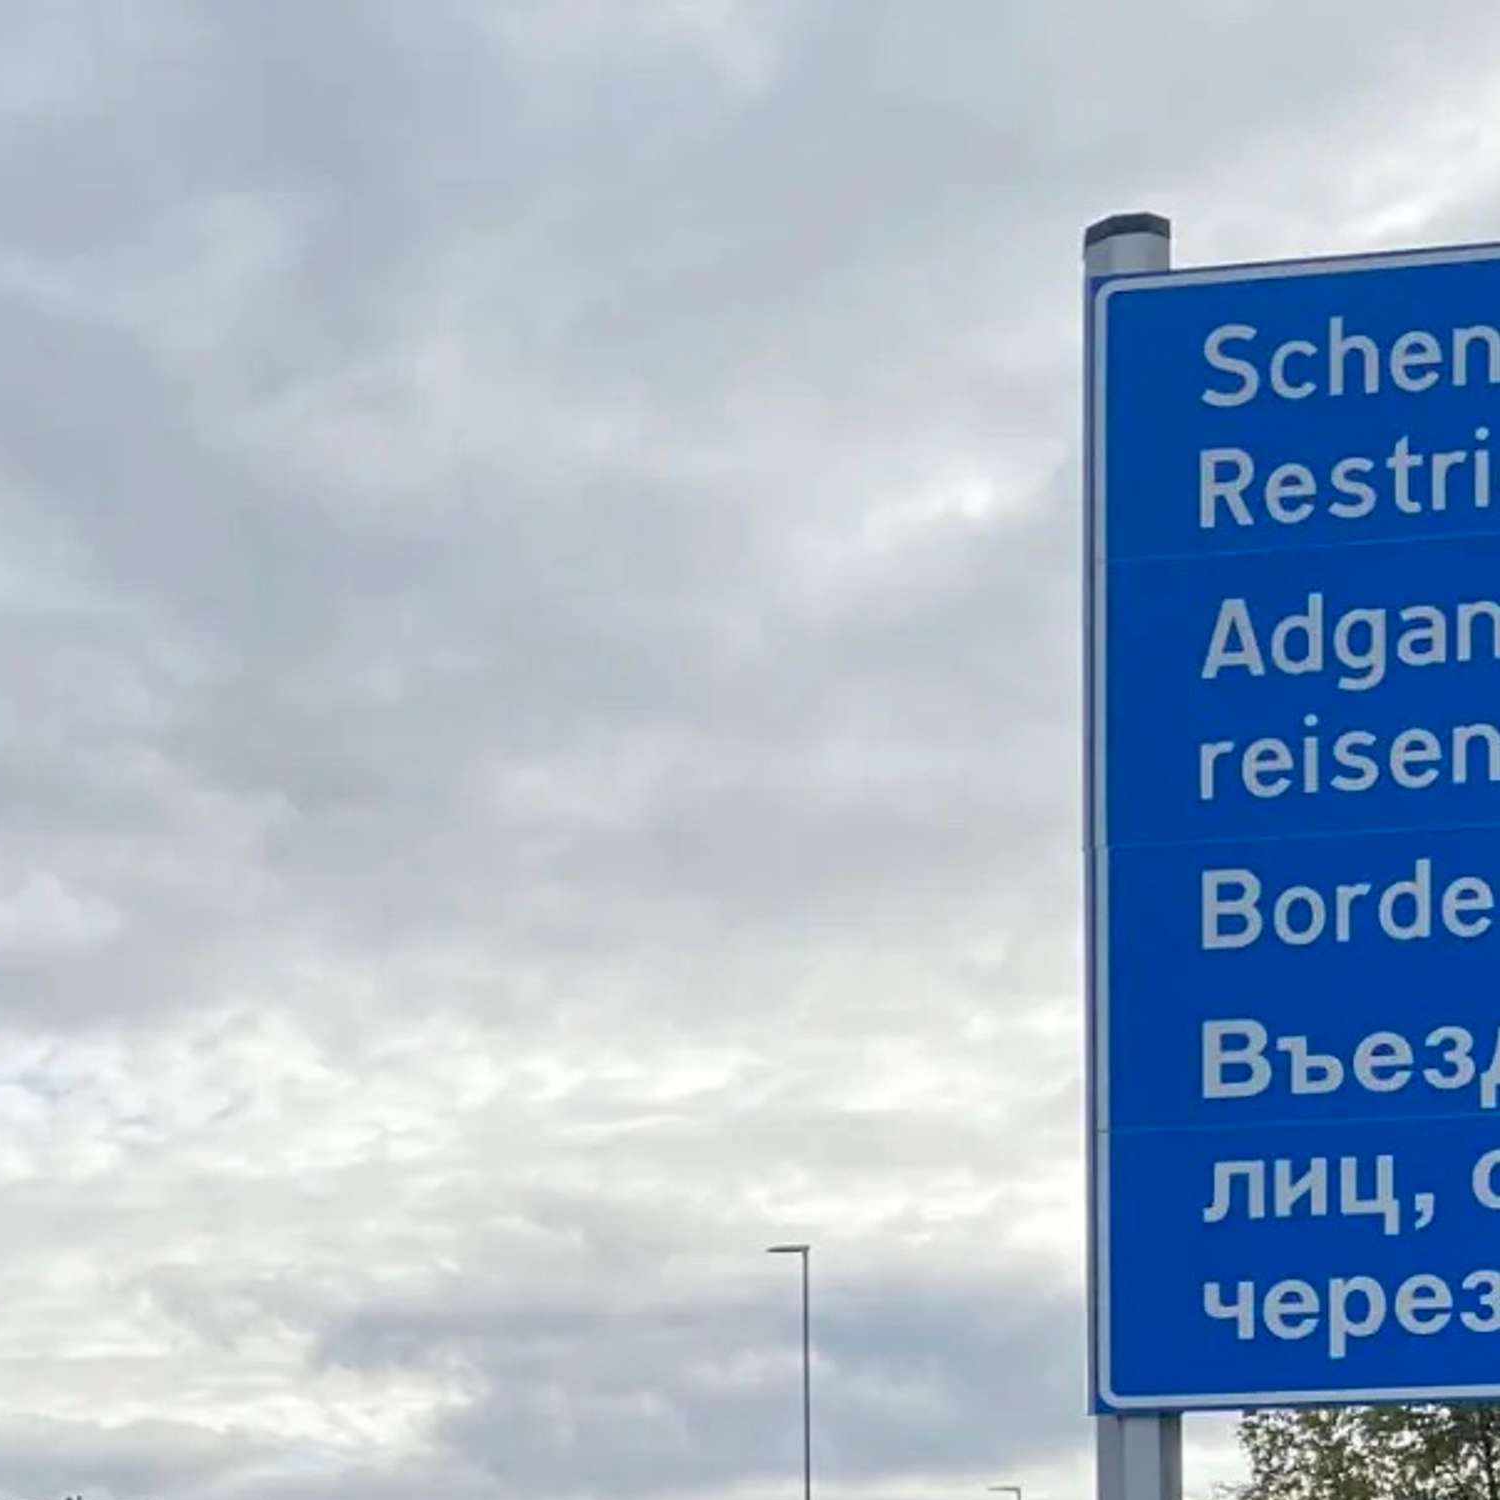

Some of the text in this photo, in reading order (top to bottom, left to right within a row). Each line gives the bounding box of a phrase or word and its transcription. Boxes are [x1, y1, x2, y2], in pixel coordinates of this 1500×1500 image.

[1202, 316, 1500, 407] Schen
[1200, 426, 1490, 529] Restri
[1201, 592, 1500, 690] Adgan
[1200, 714, 1500, 800] reisen
[1202, 858, 1495, 950] Borde
[1203, 1154, 1435, 1235] лиц,
[1203, 1269, 1500, 1359] через
